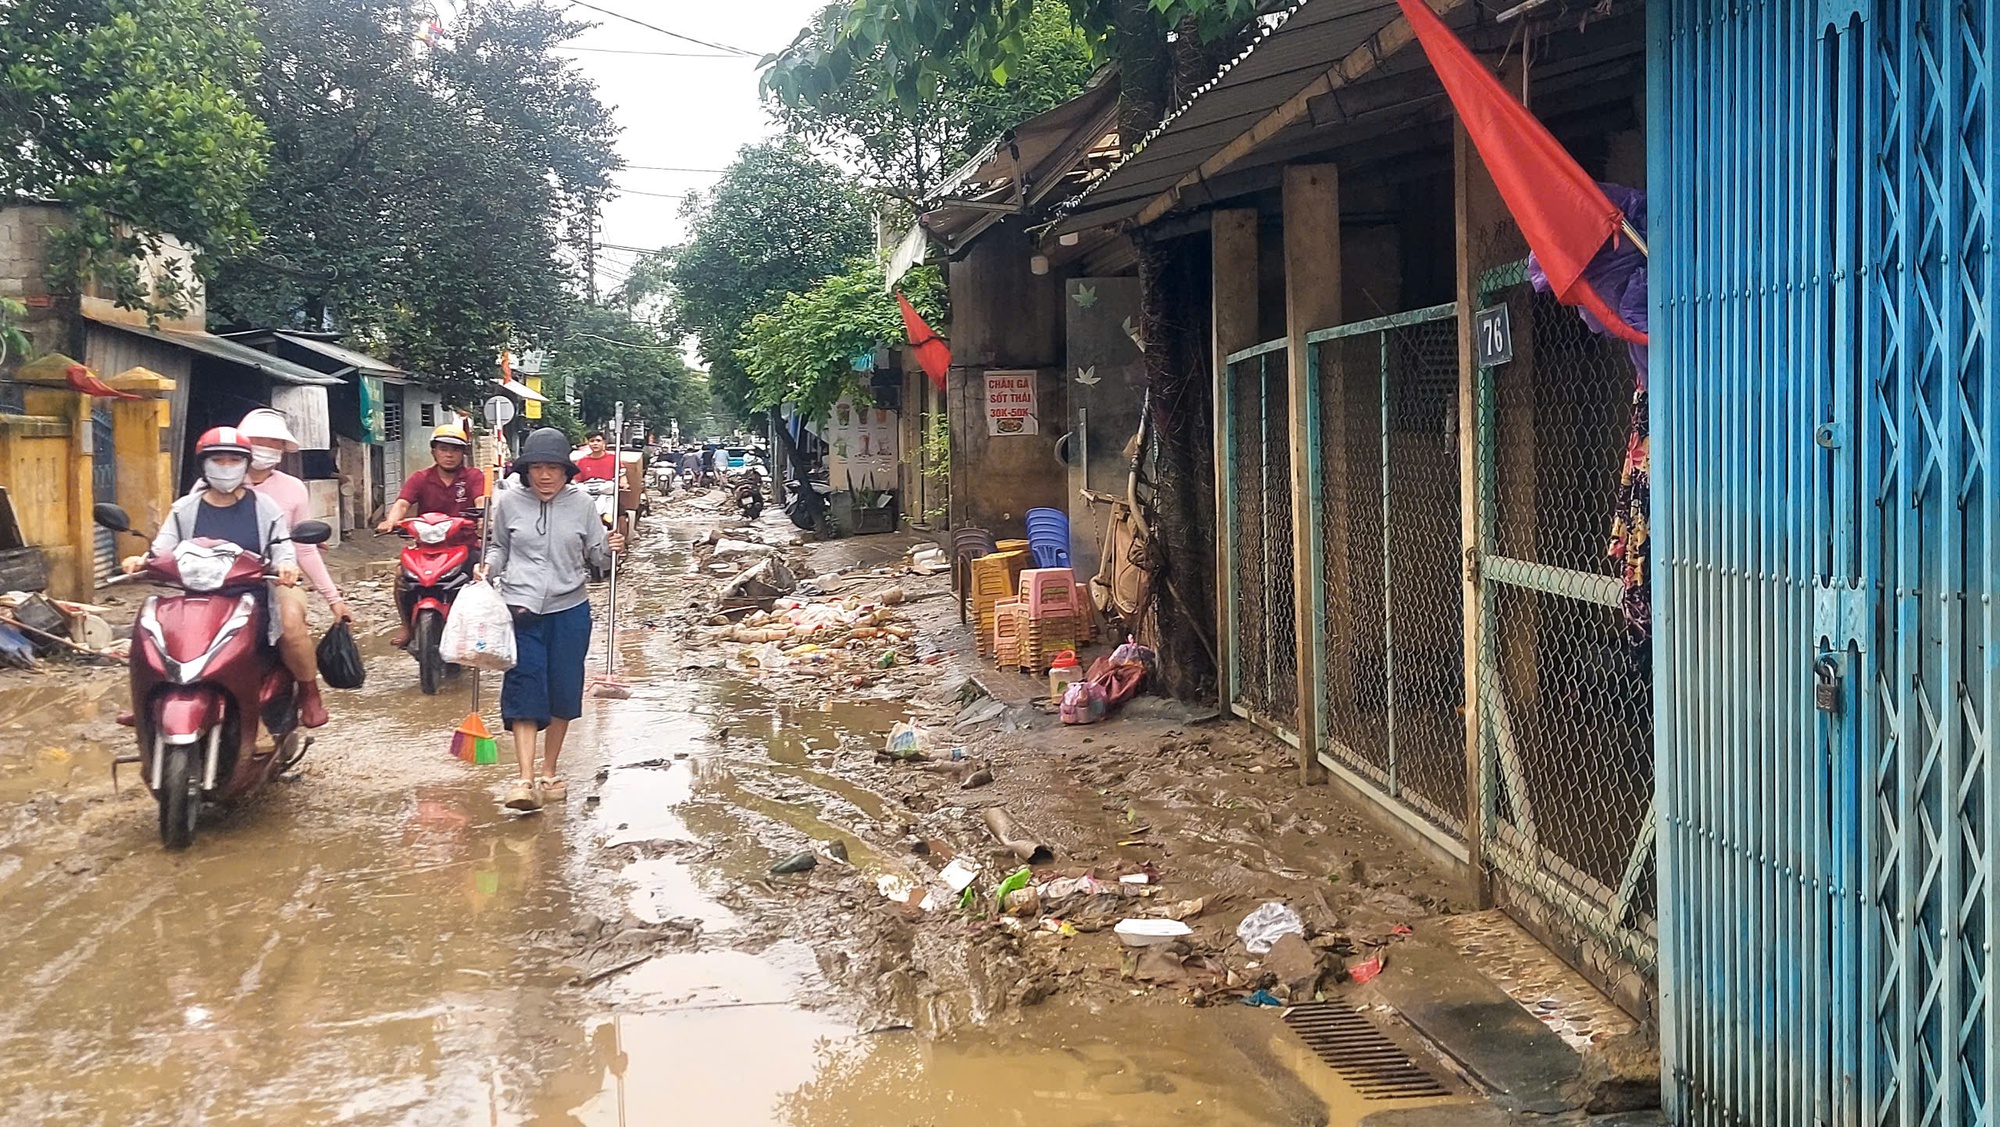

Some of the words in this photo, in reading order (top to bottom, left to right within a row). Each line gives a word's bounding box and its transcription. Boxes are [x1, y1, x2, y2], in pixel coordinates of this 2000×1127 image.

[1483, 317, 1503, 356] 76
[988, 377, 1014, 389] CHÂN
[1016, 377, 1029, 389] GÀ
[1010, 392, 1031, 403] THÁI
